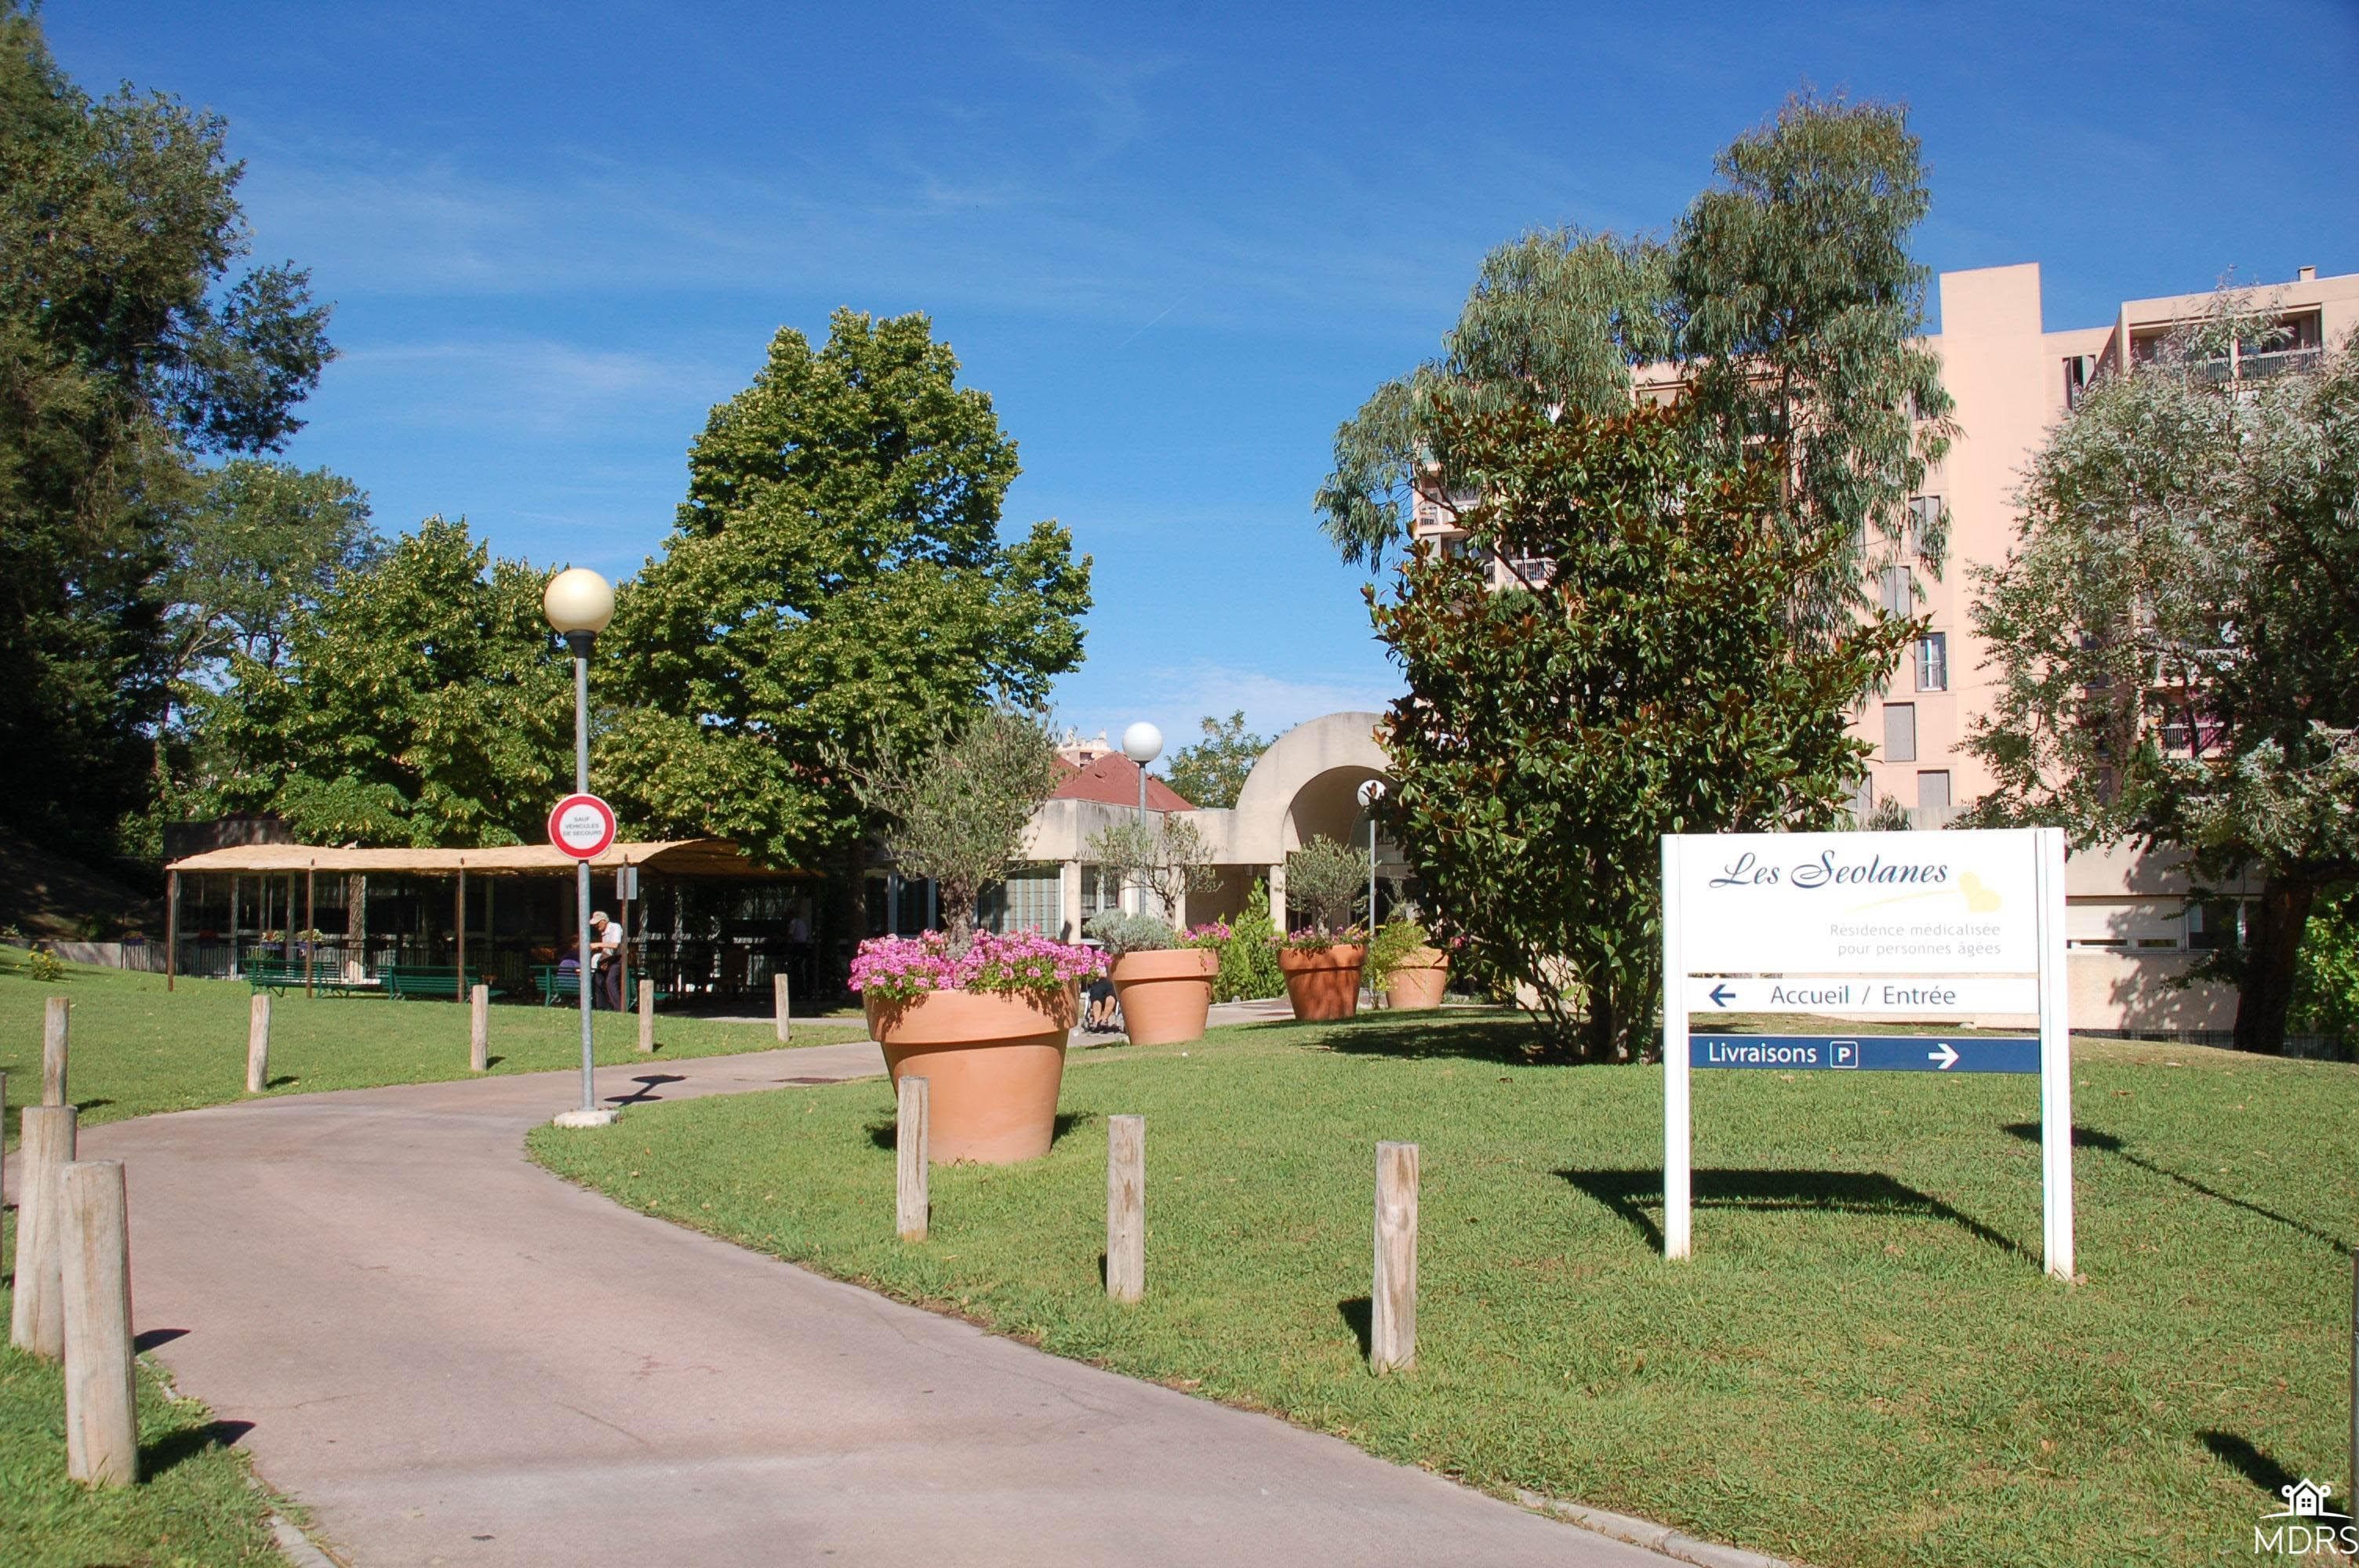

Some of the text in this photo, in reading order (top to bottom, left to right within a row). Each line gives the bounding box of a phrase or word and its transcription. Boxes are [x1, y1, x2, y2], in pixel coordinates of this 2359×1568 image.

[1709, 850, 1948, 889] Les Seolanes
[1830, 922, 2001, 937] Résidence médicalisée
[1838, 942, 2001, 957] pour personnes âgées
[1770, 985, 1956, 1005] Accueil / Entrée
[1709, 1042, 1851, 1064] Livraisons P
